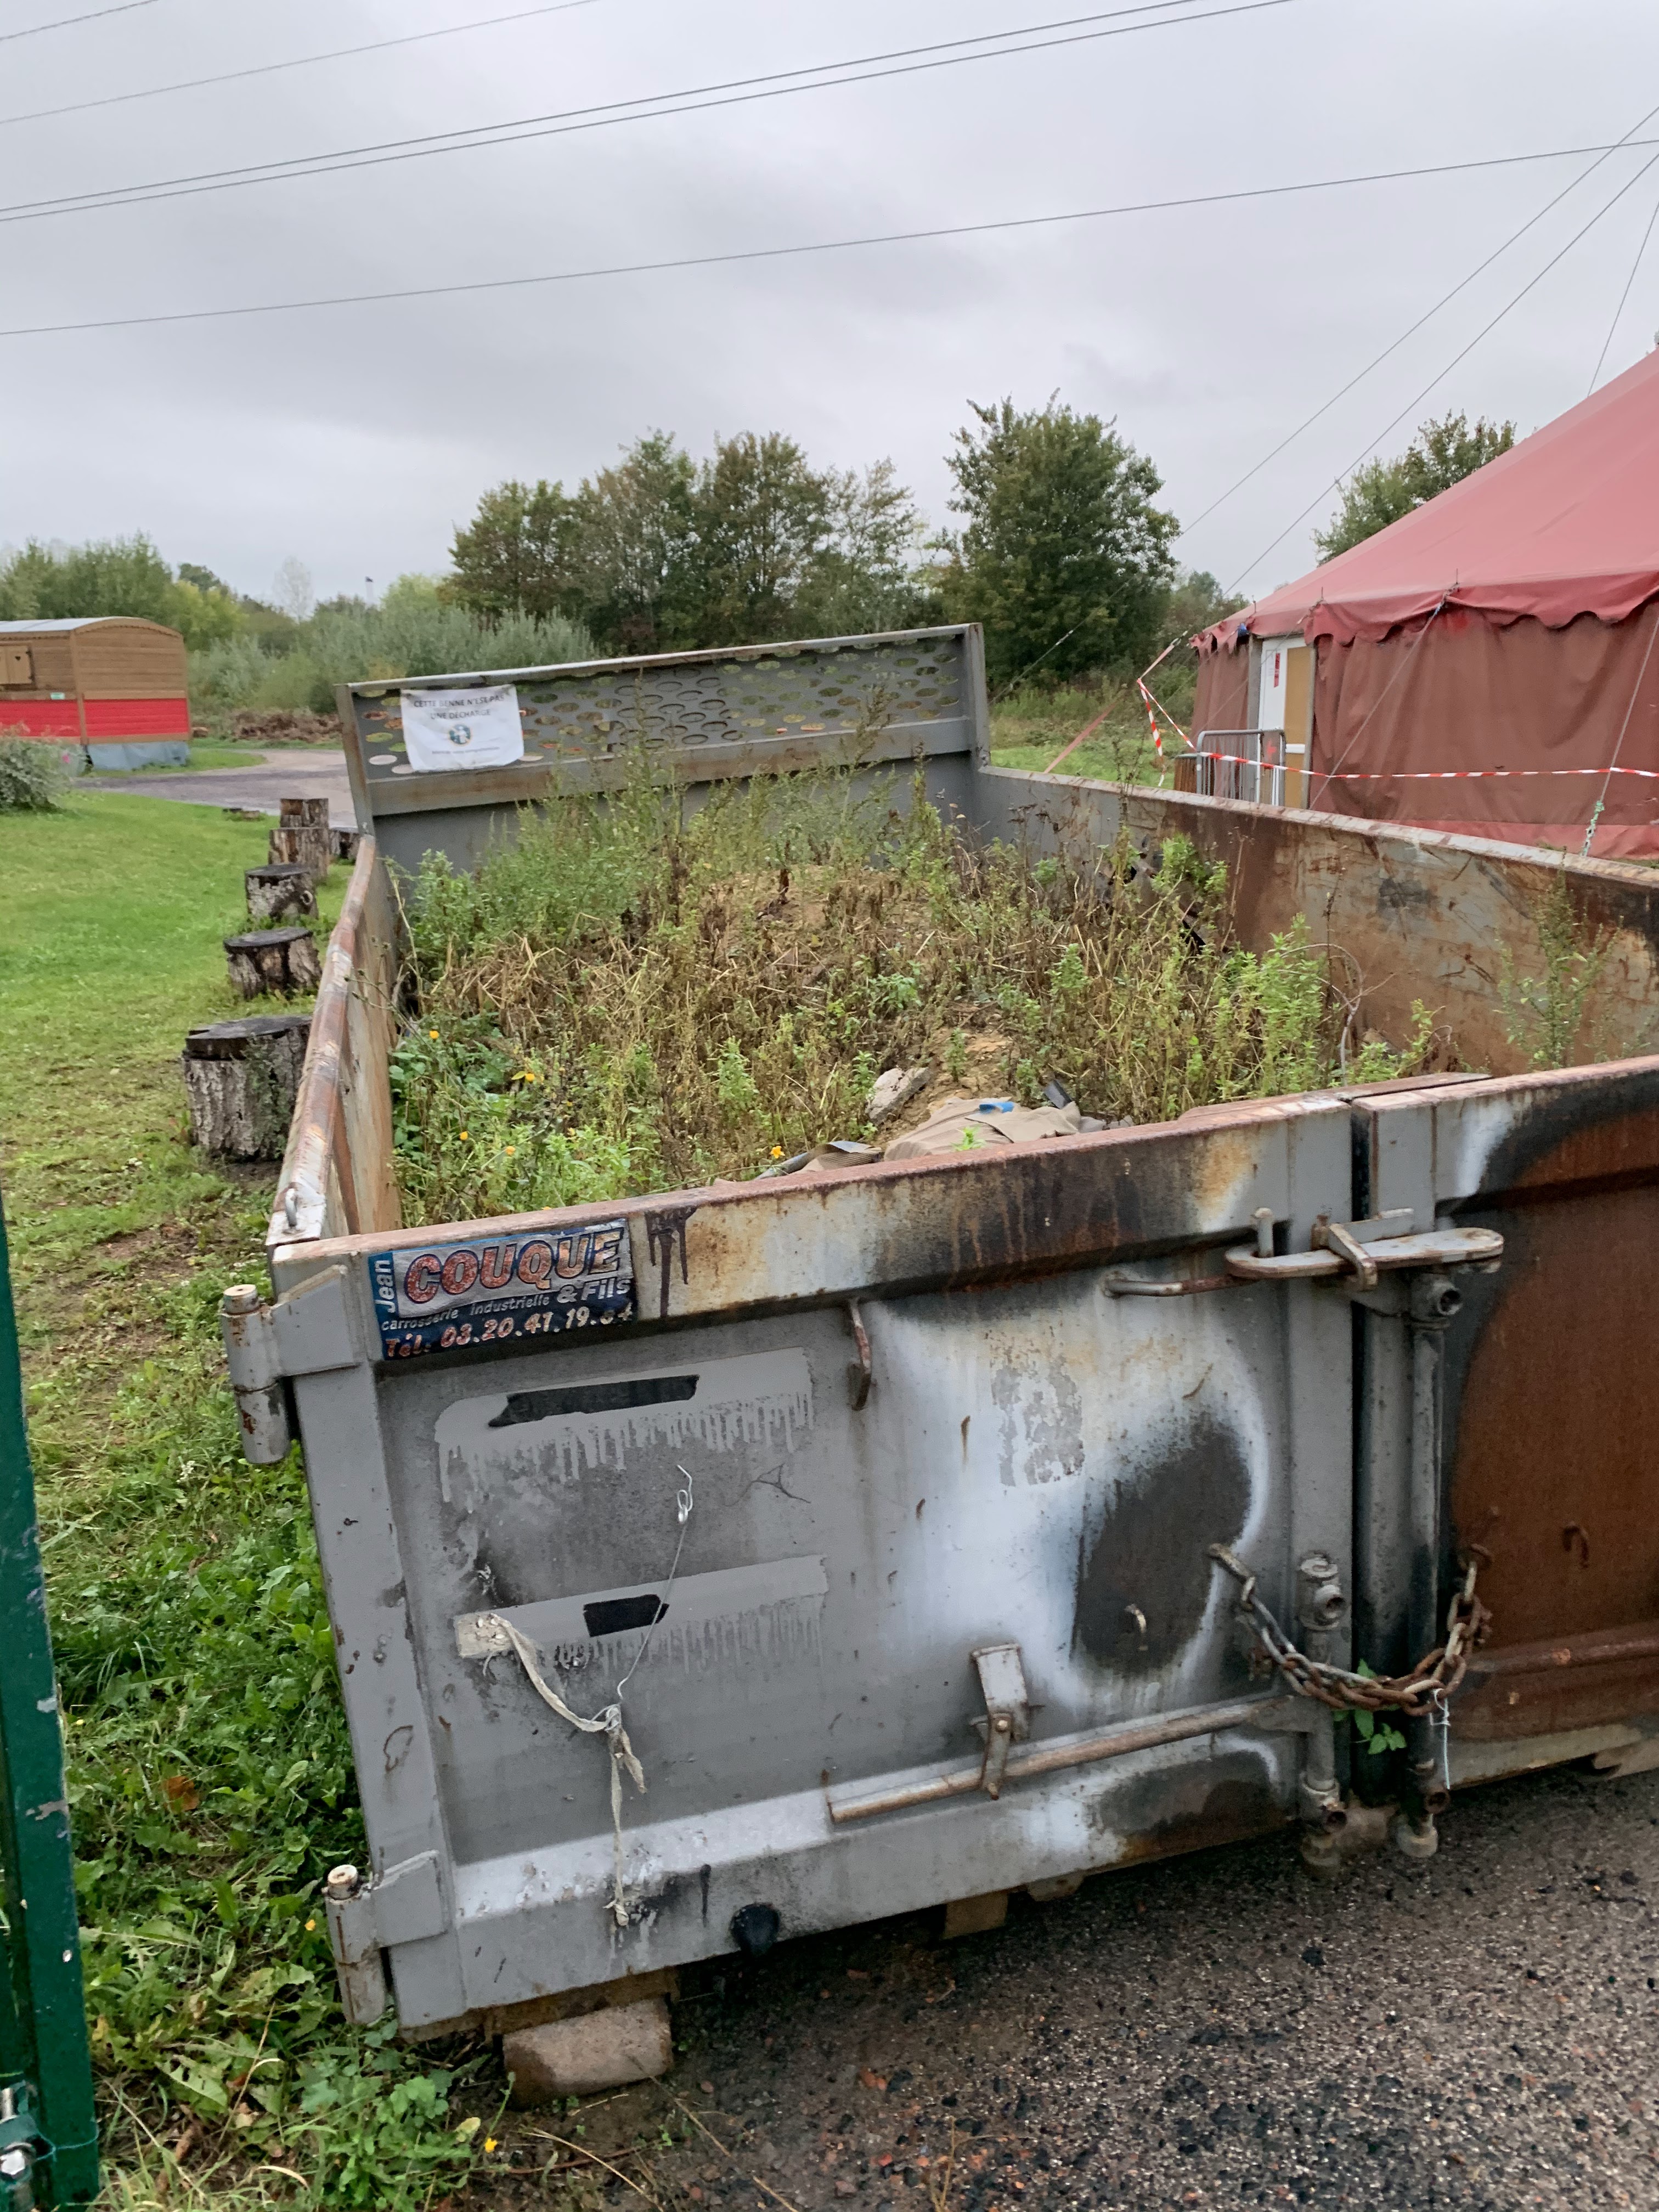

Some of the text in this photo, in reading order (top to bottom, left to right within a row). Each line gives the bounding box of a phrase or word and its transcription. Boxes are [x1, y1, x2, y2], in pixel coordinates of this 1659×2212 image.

[376, 1260, 396, 1313] Jean
[405, 1227, 623, 1304] COUQUE
[381, 1294, 549, 1331] carrosserie industrielle
[556, 1278, 630, 1304] & Fils
